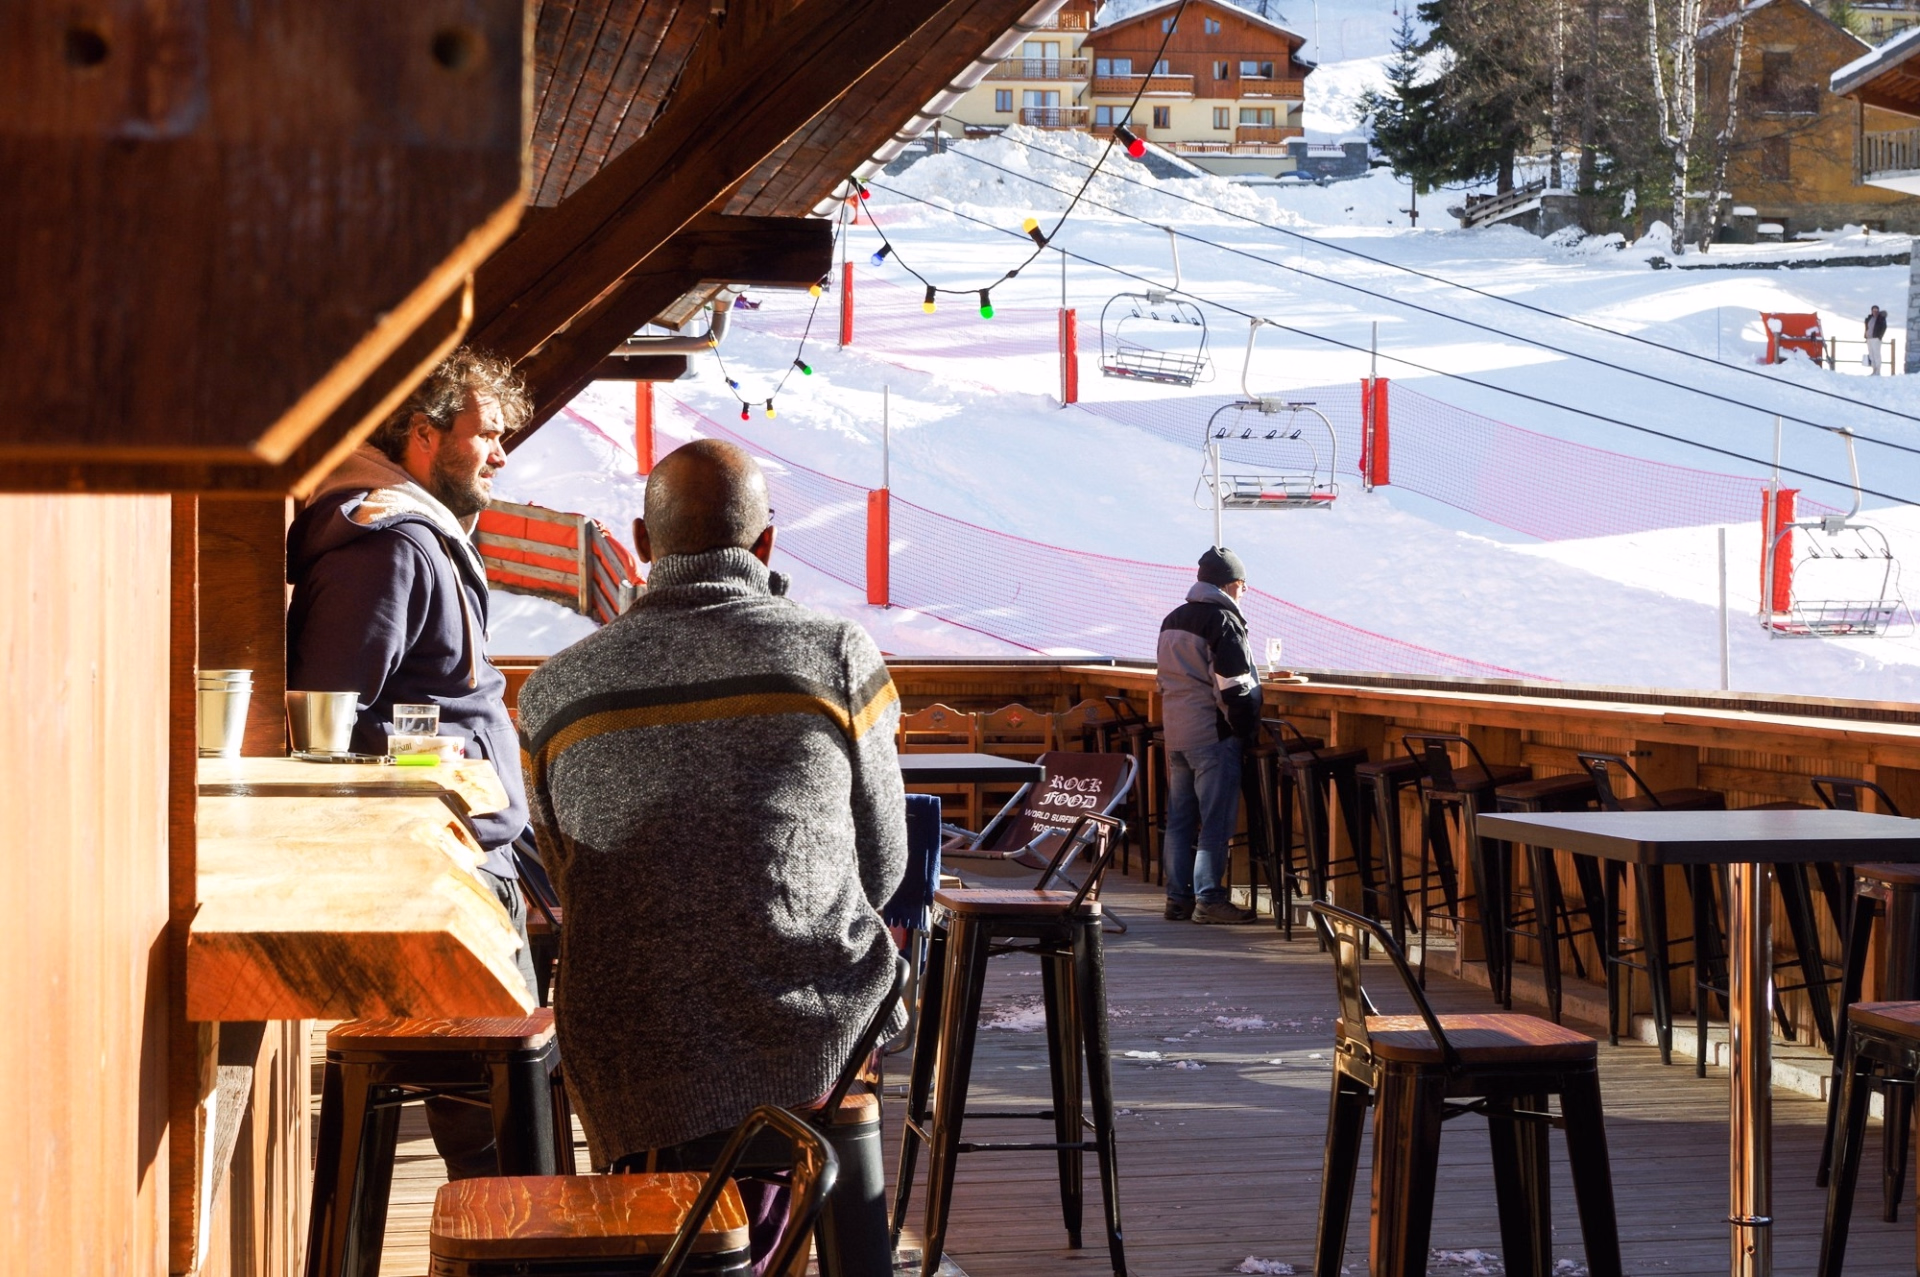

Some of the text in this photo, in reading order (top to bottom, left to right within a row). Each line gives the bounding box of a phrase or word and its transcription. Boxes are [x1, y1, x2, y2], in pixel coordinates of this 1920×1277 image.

[1049, 775, 1102, 792] ROCK
[1039, 791, 1097, 809] FOOD
[1024, 809, 1051, 820] WORLD
